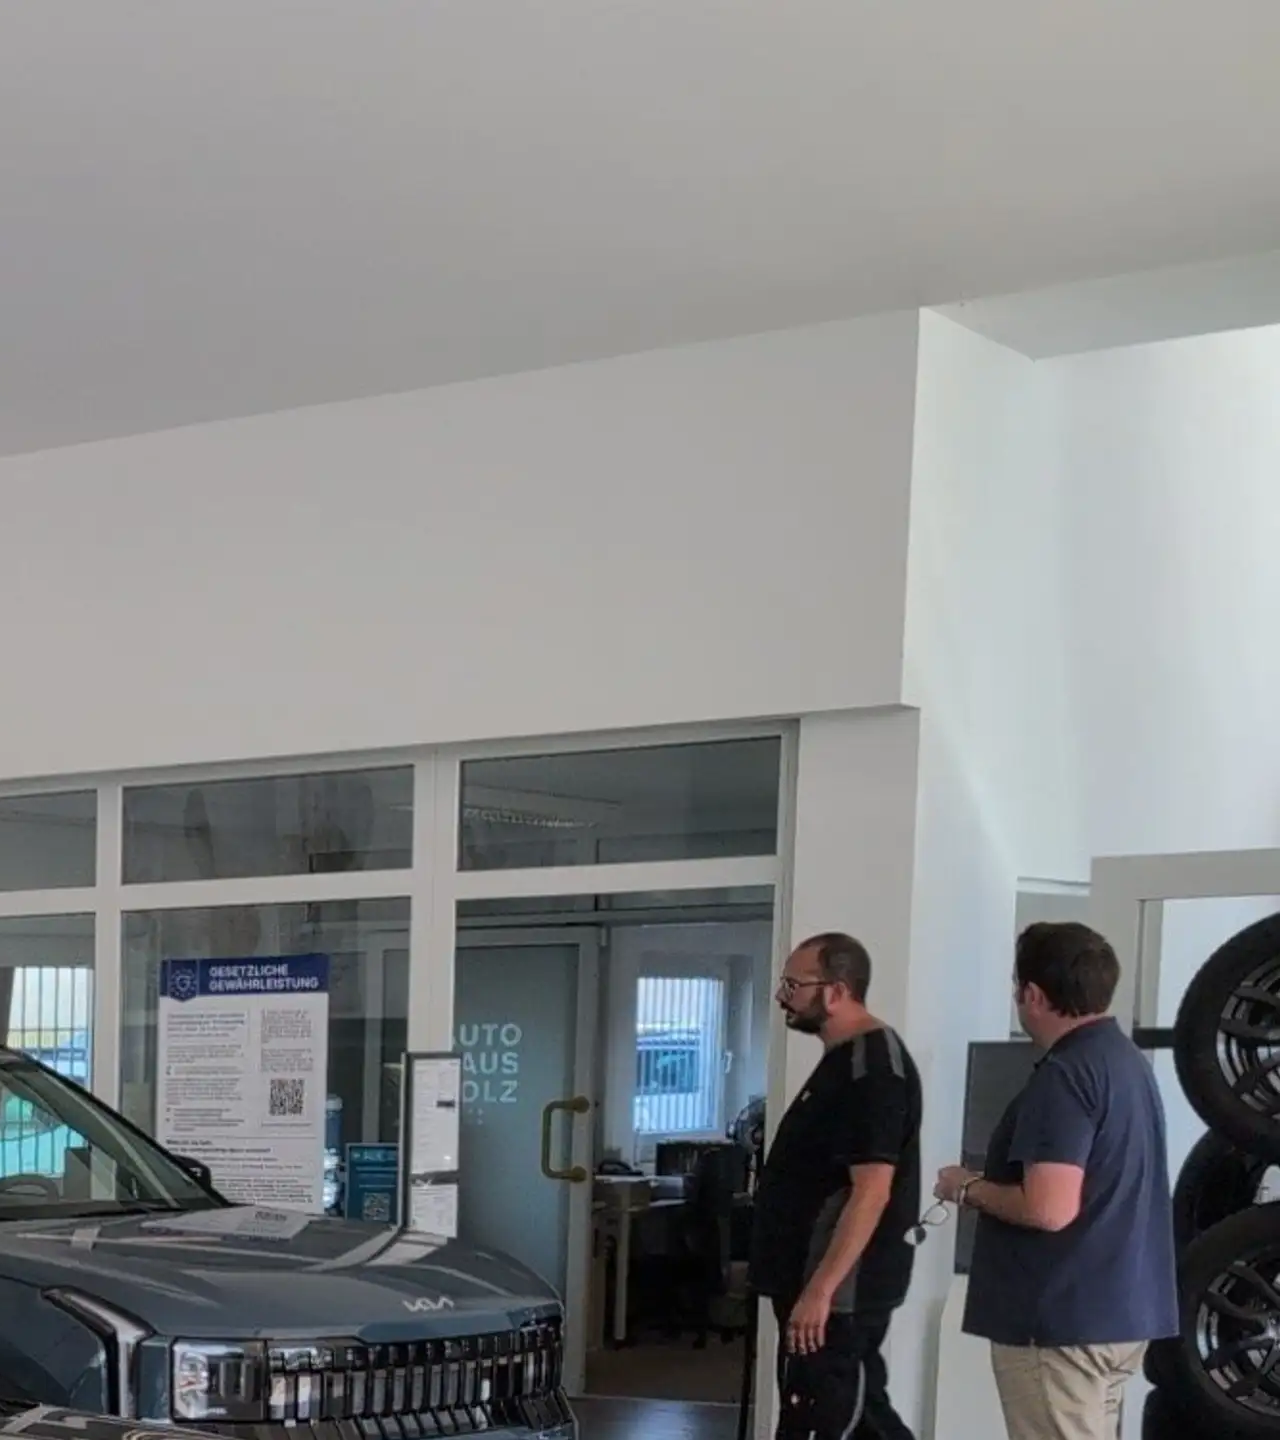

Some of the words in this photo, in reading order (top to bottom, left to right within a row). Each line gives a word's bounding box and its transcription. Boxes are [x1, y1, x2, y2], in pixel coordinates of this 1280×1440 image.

[209, 963, 289, 978] GESETZLICHE
[209, 976, 319, 992] GEWÄHRLEISTUNG
[453, 1023, 522, 1047] UTO
[462, 1051, 518, 1075] AUS
[462, 1080, 518, 1103] OLZ
